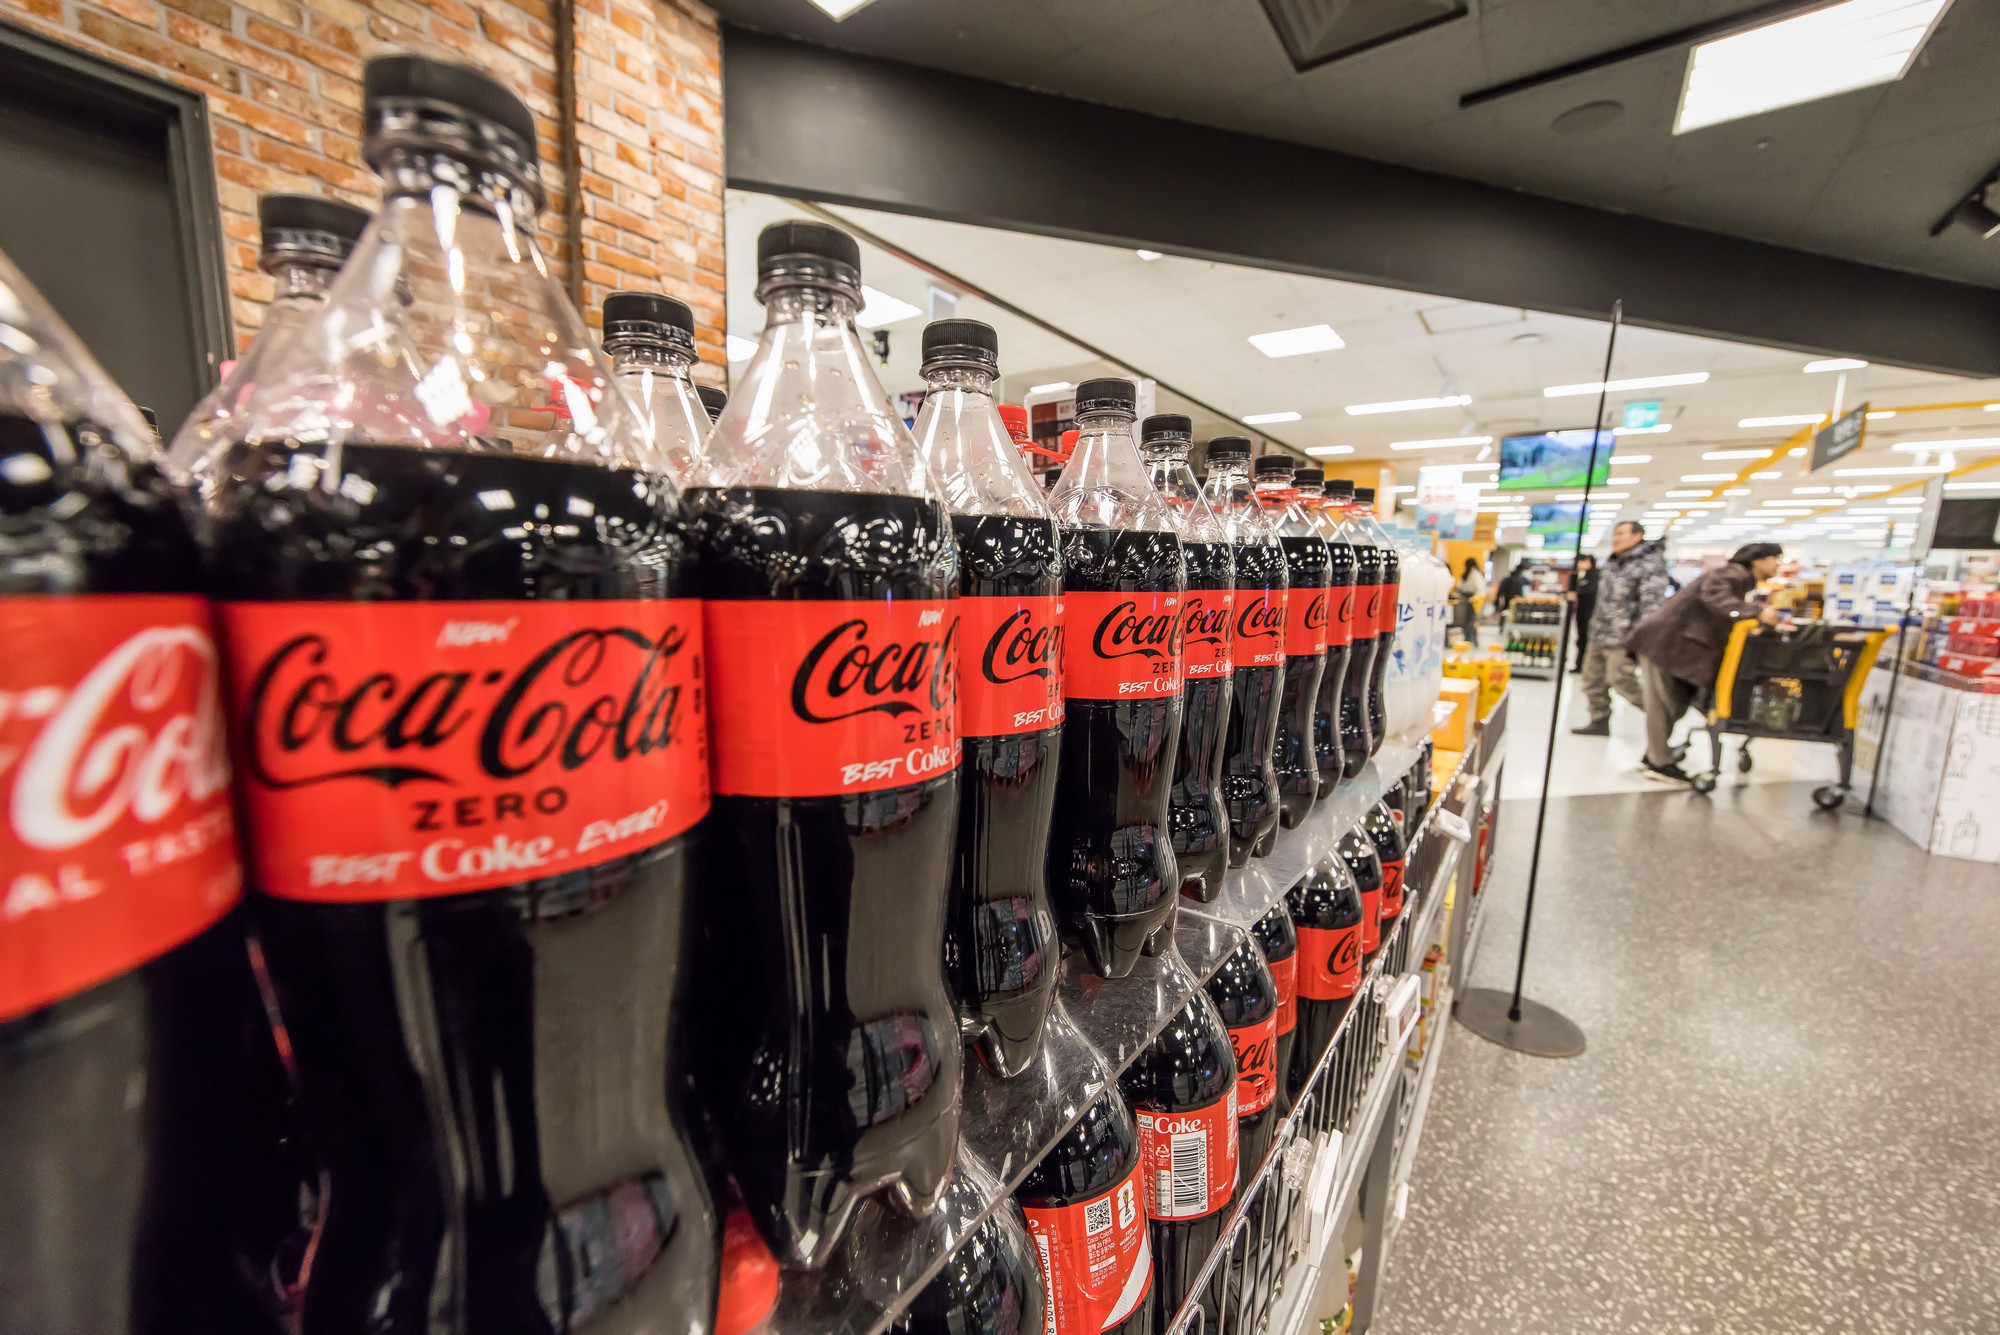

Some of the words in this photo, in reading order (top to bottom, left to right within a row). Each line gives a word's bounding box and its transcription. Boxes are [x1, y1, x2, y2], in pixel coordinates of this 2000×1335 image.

[1253, 653, 1275, 663] BEST
[1189, 663, 1214, 675] BEST
[1118, 681, 1152, 694] BEST
[1153, 677, 1179, 693] Coke
[248, 625, 688, 790] Coca-Cola
[1013, 708, 1048, 728] BEST
[840, 757, 903, 786] BEST
[905, 744, 951, 775] Coke
[412, 787, 568, 831] ZERO
[420, 834, 553, 882] Coke
[1154, 1116, 1201, 1134] Coke
